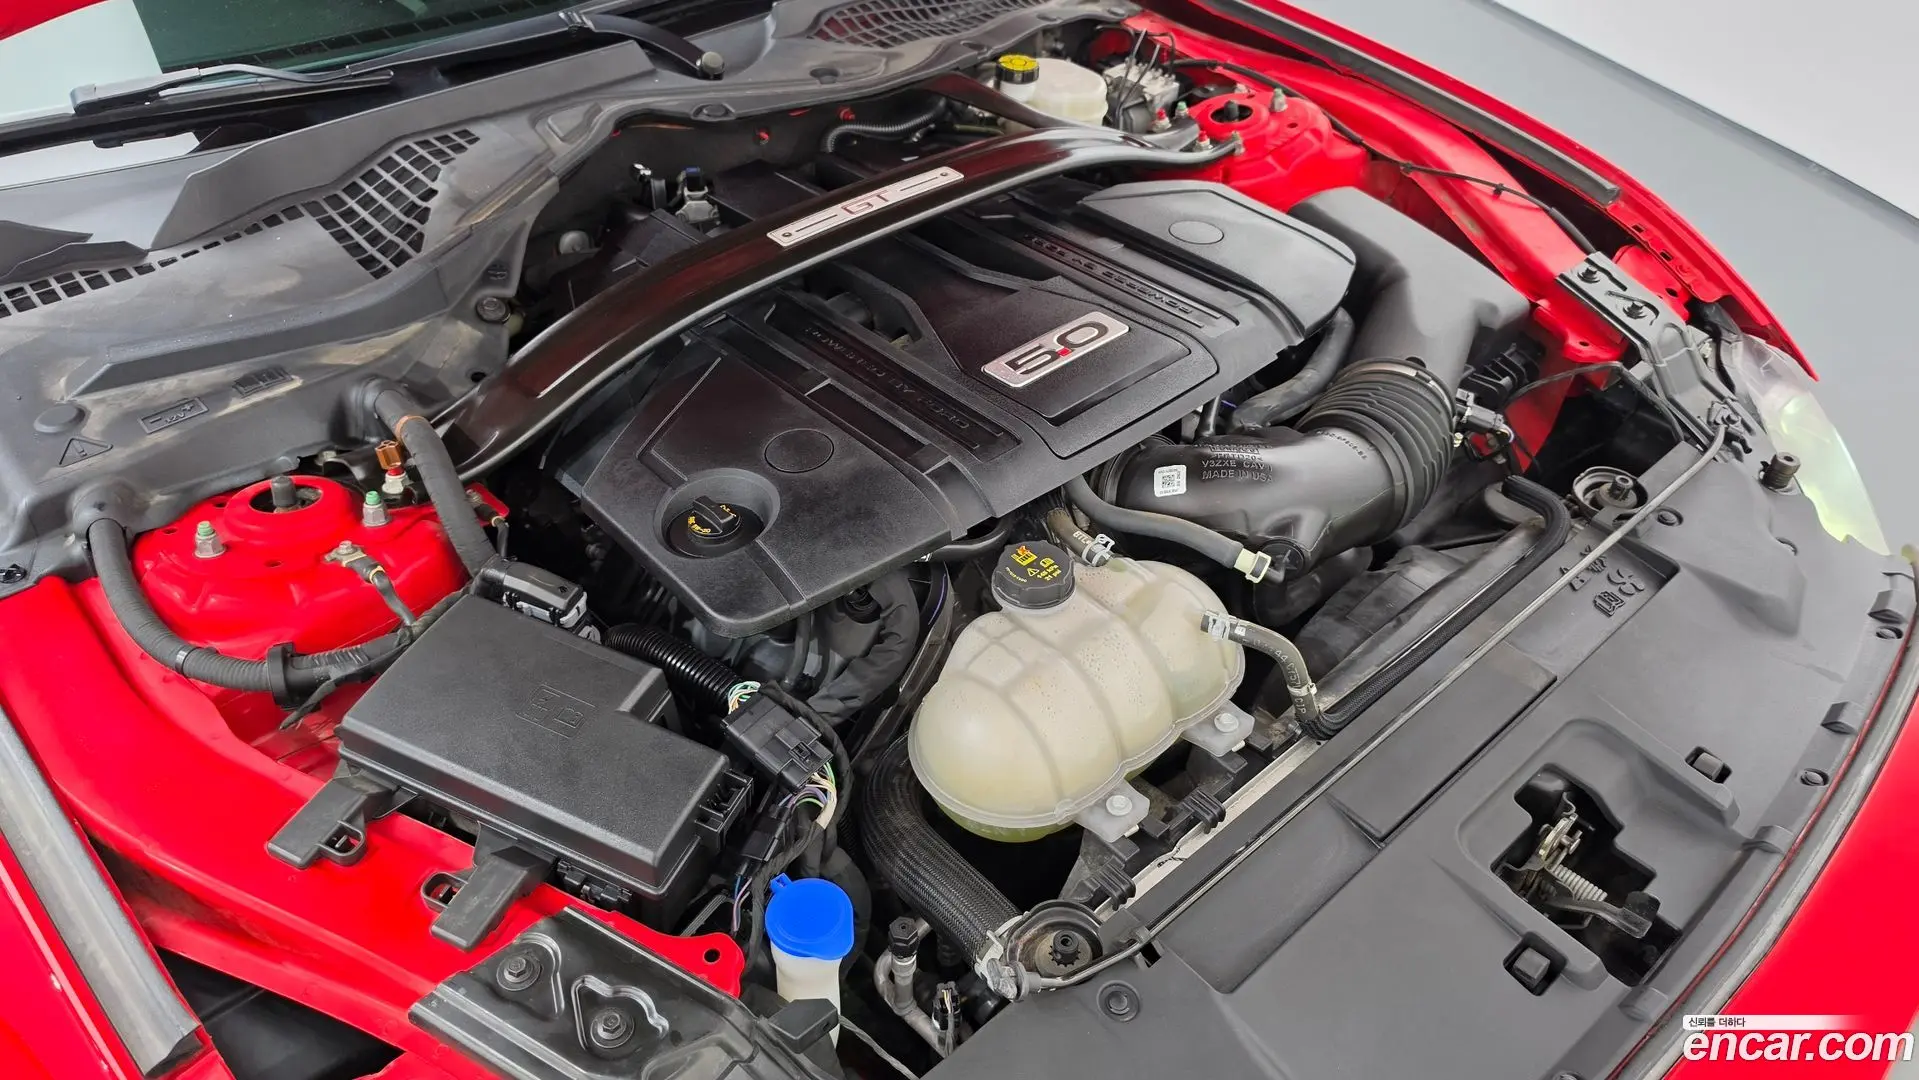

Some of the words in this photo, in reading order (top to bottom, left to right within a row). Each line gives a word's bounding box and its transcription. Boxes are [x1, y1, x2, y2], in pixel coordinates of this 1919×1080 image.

[840, 189, 891, 216] GT
[1004, 320, 1109, 376] 5.0
[1201, 469, 1235, 480] MADE
[1238, 469, 1249, 479] IN
[1252, 471, 1274, 483] USA
